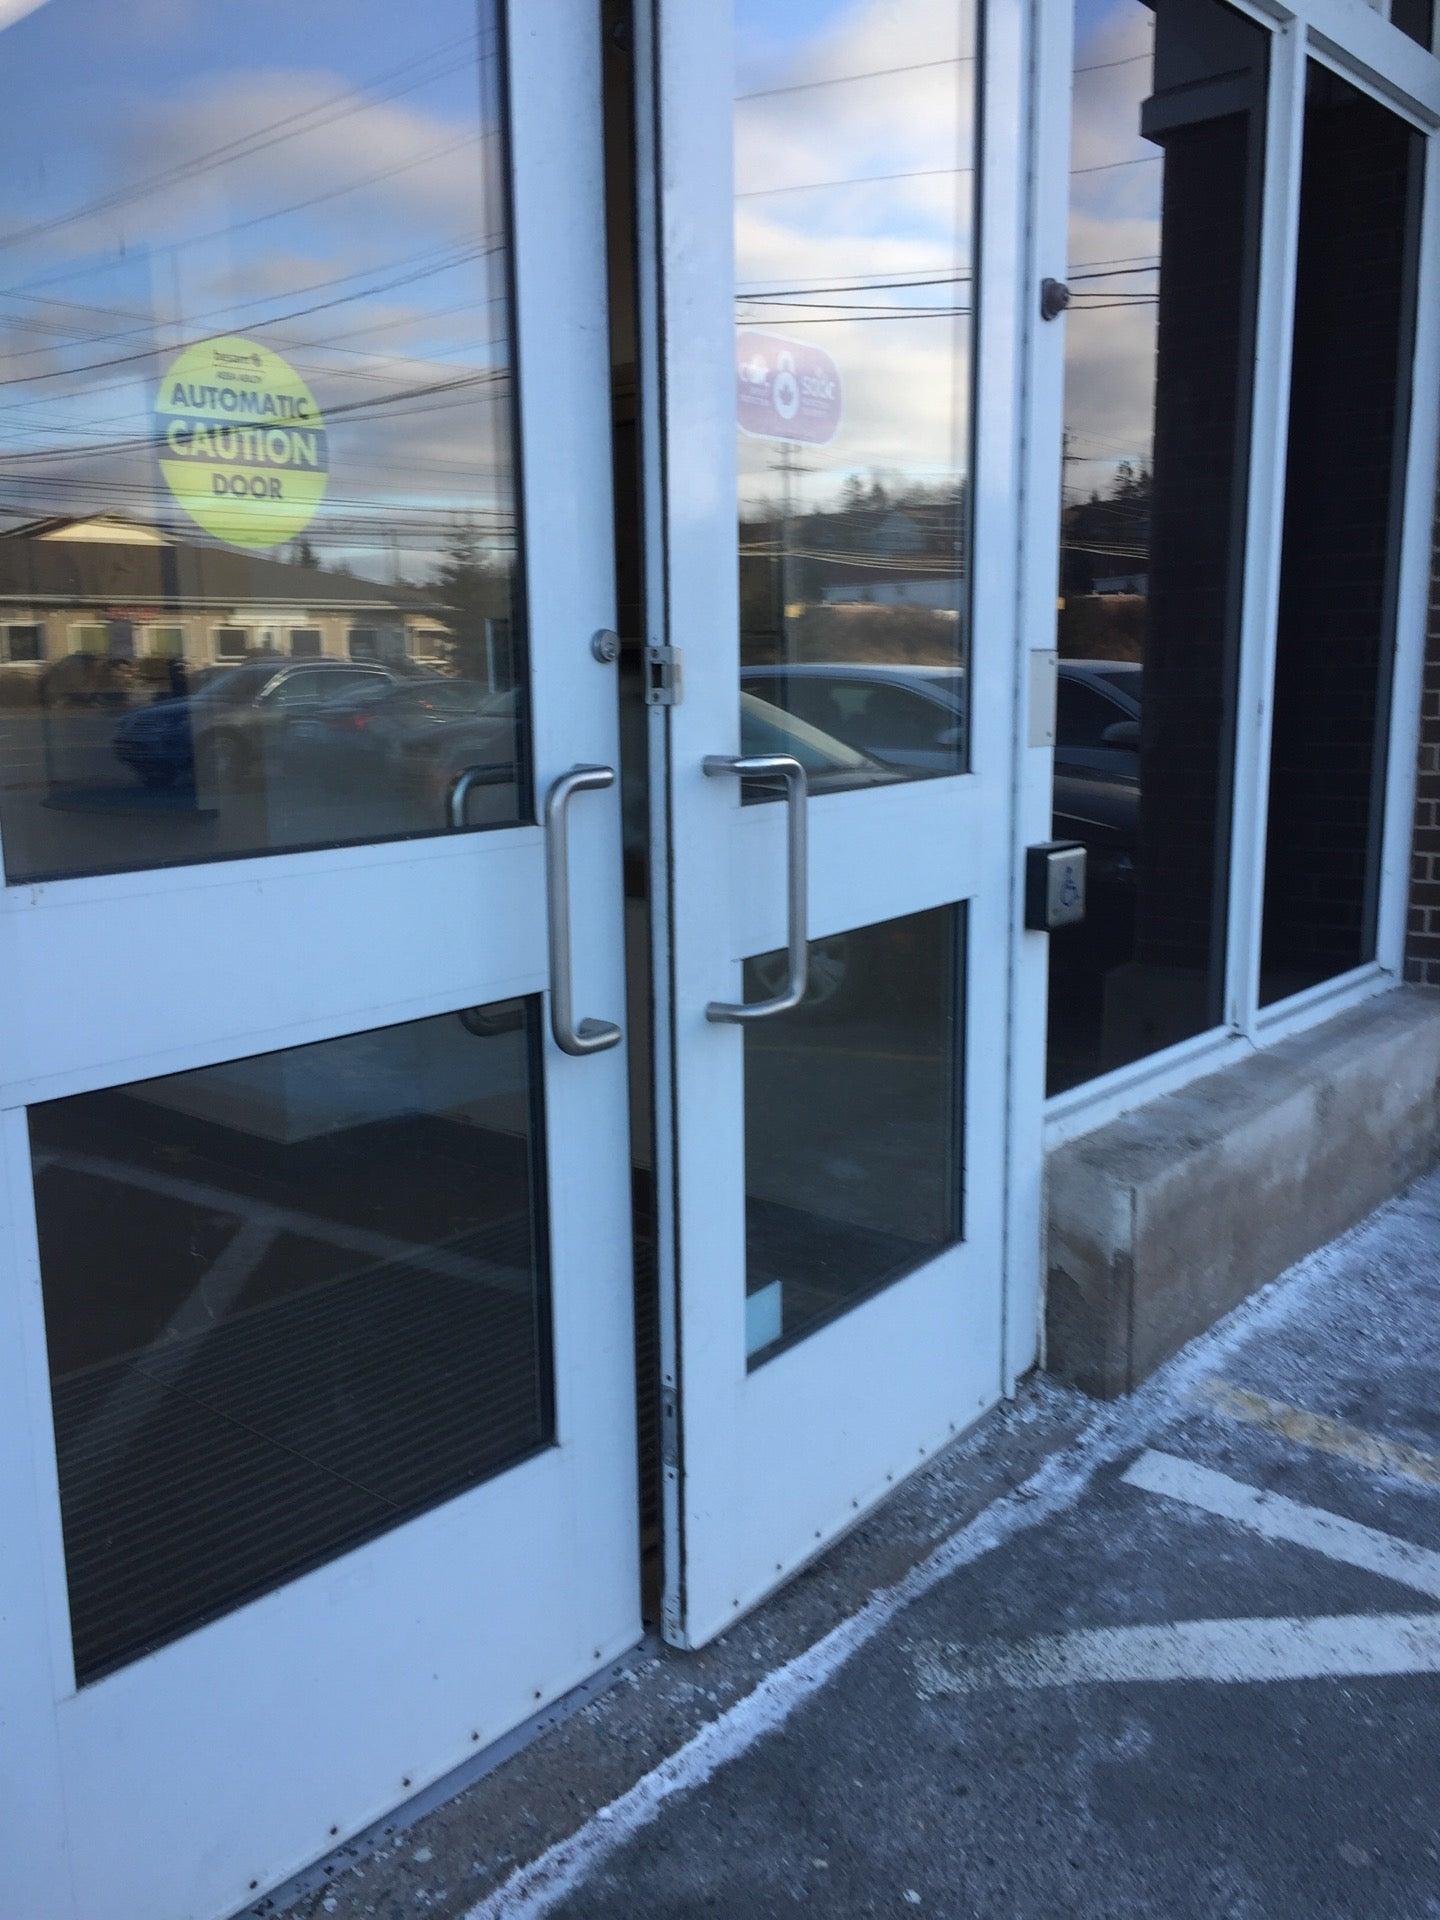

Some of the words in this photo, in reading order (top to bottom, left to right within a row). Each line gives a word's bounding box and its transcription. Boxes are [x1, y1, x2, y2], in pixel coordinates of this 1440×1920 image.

[171, 382, 309, 419] AUTOMATIC
[167, 419, 318, 466] CAUTION
[212, 472, 283, 500] DOOR
